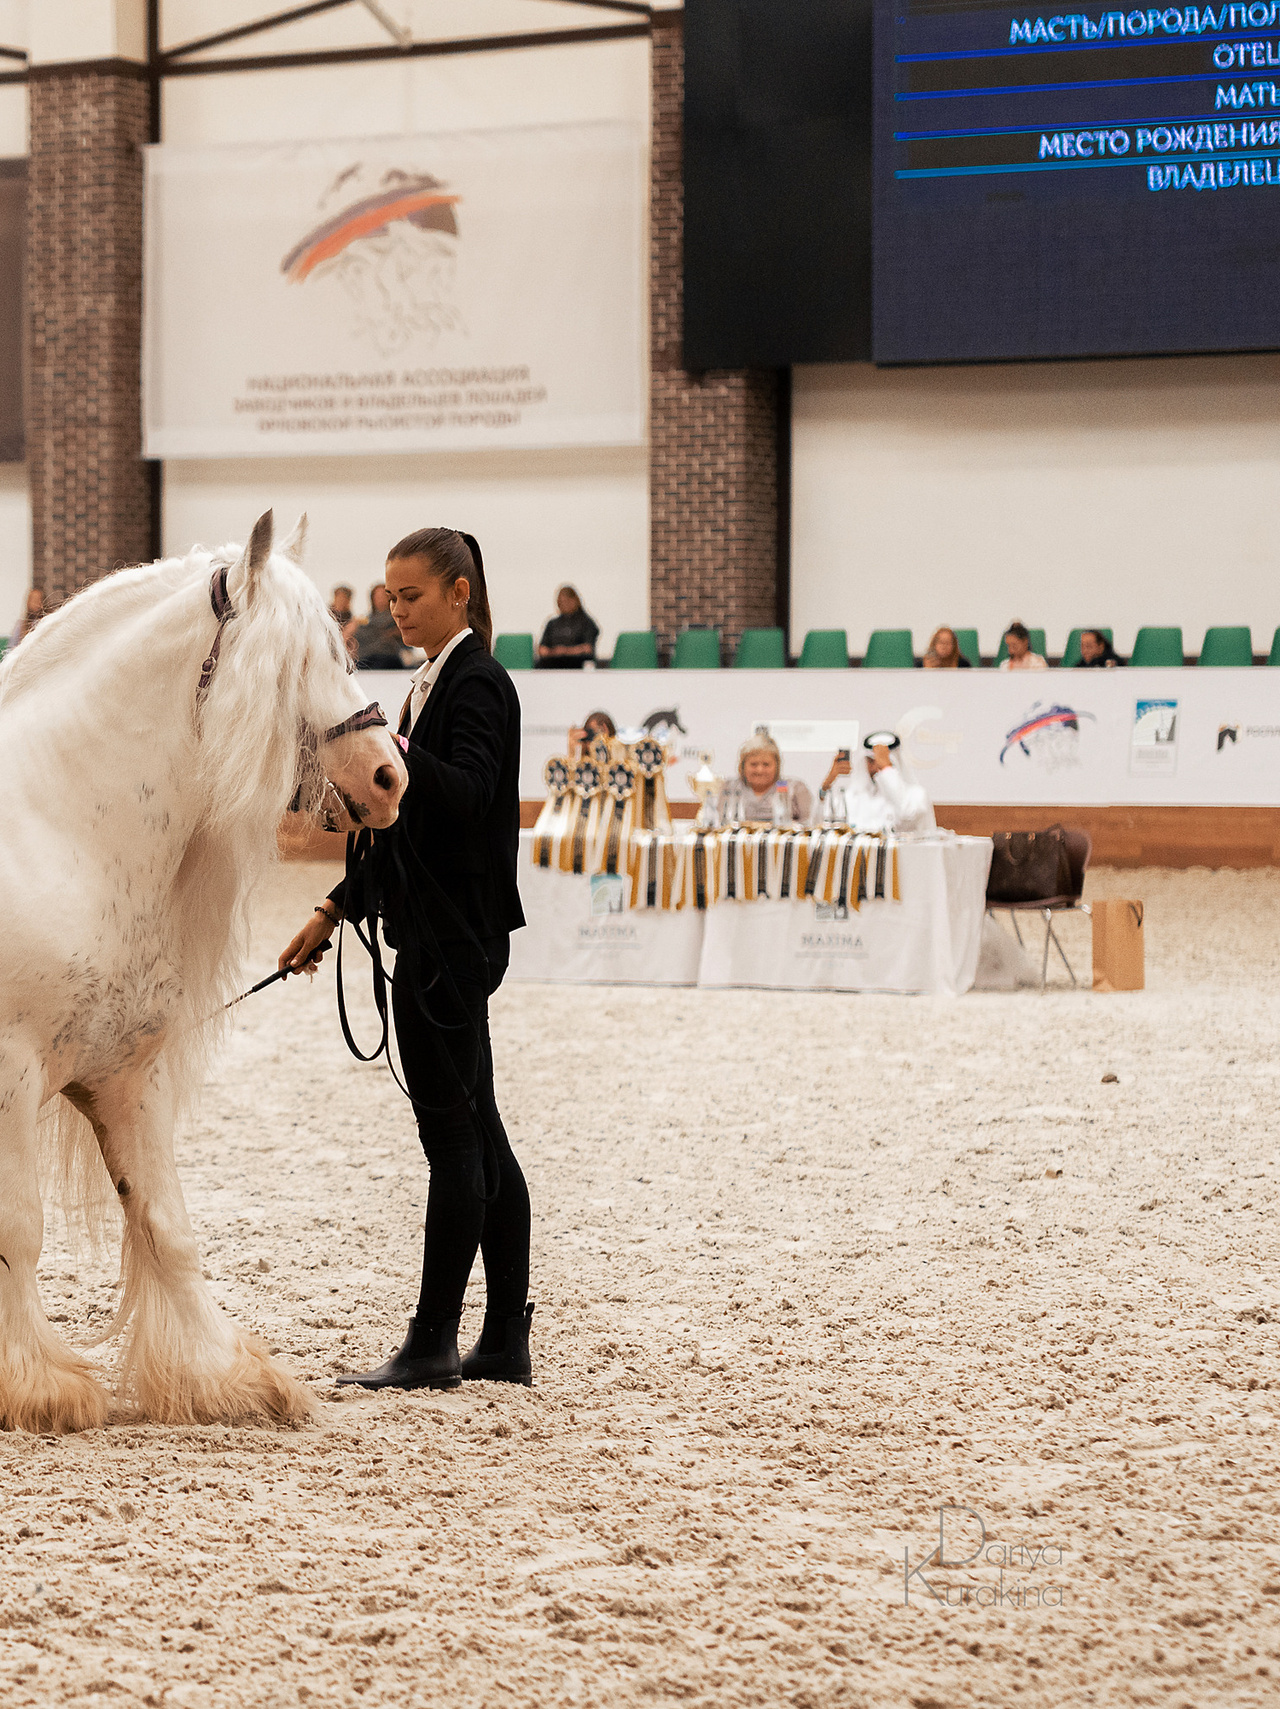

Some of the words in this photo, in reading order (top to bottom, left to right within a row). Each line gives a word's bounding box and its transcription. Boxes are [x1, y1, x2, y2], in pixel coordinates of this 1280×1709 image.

[1038, 129, 1131, 159] МЕСТО
[1135, 120, 1280, 154] РОЖДЕНИЯ
[801, 933, 863, 947] MAXIMA
